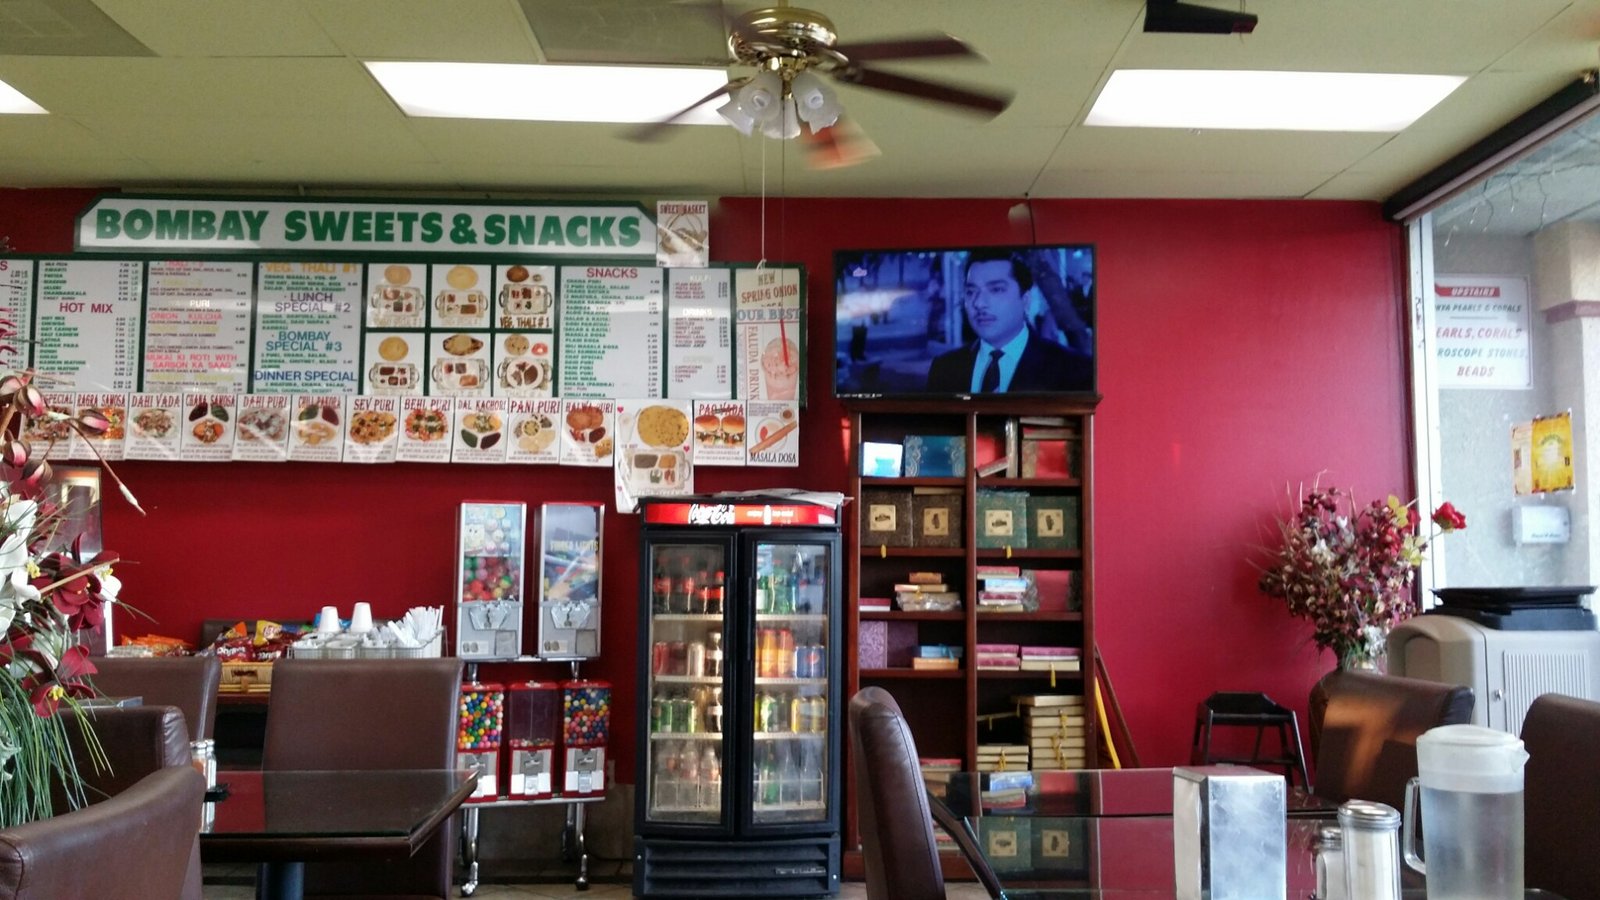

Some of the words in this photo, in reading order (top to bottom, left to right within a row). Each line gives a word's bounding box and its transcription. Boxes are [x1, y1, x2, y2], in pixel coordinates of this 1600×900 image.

[96, 208, 269, 241] BOMBAY
[285, 210, 444, 243] SWEETS
[484, 214, 641, 247] SNACKS
[586, 267, 639, 279] SNACKS
[290, 292, 333, 302] LUNCH
[741, 288, 772, 304] SPRING
[773, 283, 798, 299] ONION
[1451, 287, 1496, 297] UPSTAIRS
[60, 302, 85, 313] HOT
[91, 303, 113, 314] MIX
[275, 302, 328, 313] SPECIAL
[335, 302, 351, 313] #2
[1492, 304, 1521, 313] CORALS
[737, 309, 765, 321] OUR
[768, 308, 800, 320] BEST
[279, 331, 331, 341] BOMBAY
[265, 341, 319, 352] SPECIAL
[325, 342, 343, 352] #3
[748, 325, 759, 364] FALUDA
[254, 370, 302, 381] DINNER
[304, 370, 358, 382] SPECIAL
[1457, 366, 1495, 377] BEADS
[749, 368, 760, 401] DRINK
[101, 394, 126, 407] SAMOSA
[131, 395, 154, 408] DAHI
[156, 394, 181, 408] VADA
[243, 396, 265, 408] DAHI
[267, 396, 288, 408] PURI
[354, 397, 373, 411] SEV
[373, 398, 395, 412] PURI
[430, 399, 451, 412] PURI
[458, 399, 472, 410] DAL
[475, 400, 507, 411] KACHORI
[510, 400, 536, 413] PANI
[537, 400, 560, 414] PURI
[750, 453, 777, 463] MASALA
[778, 452, 797, 463] DOSA
